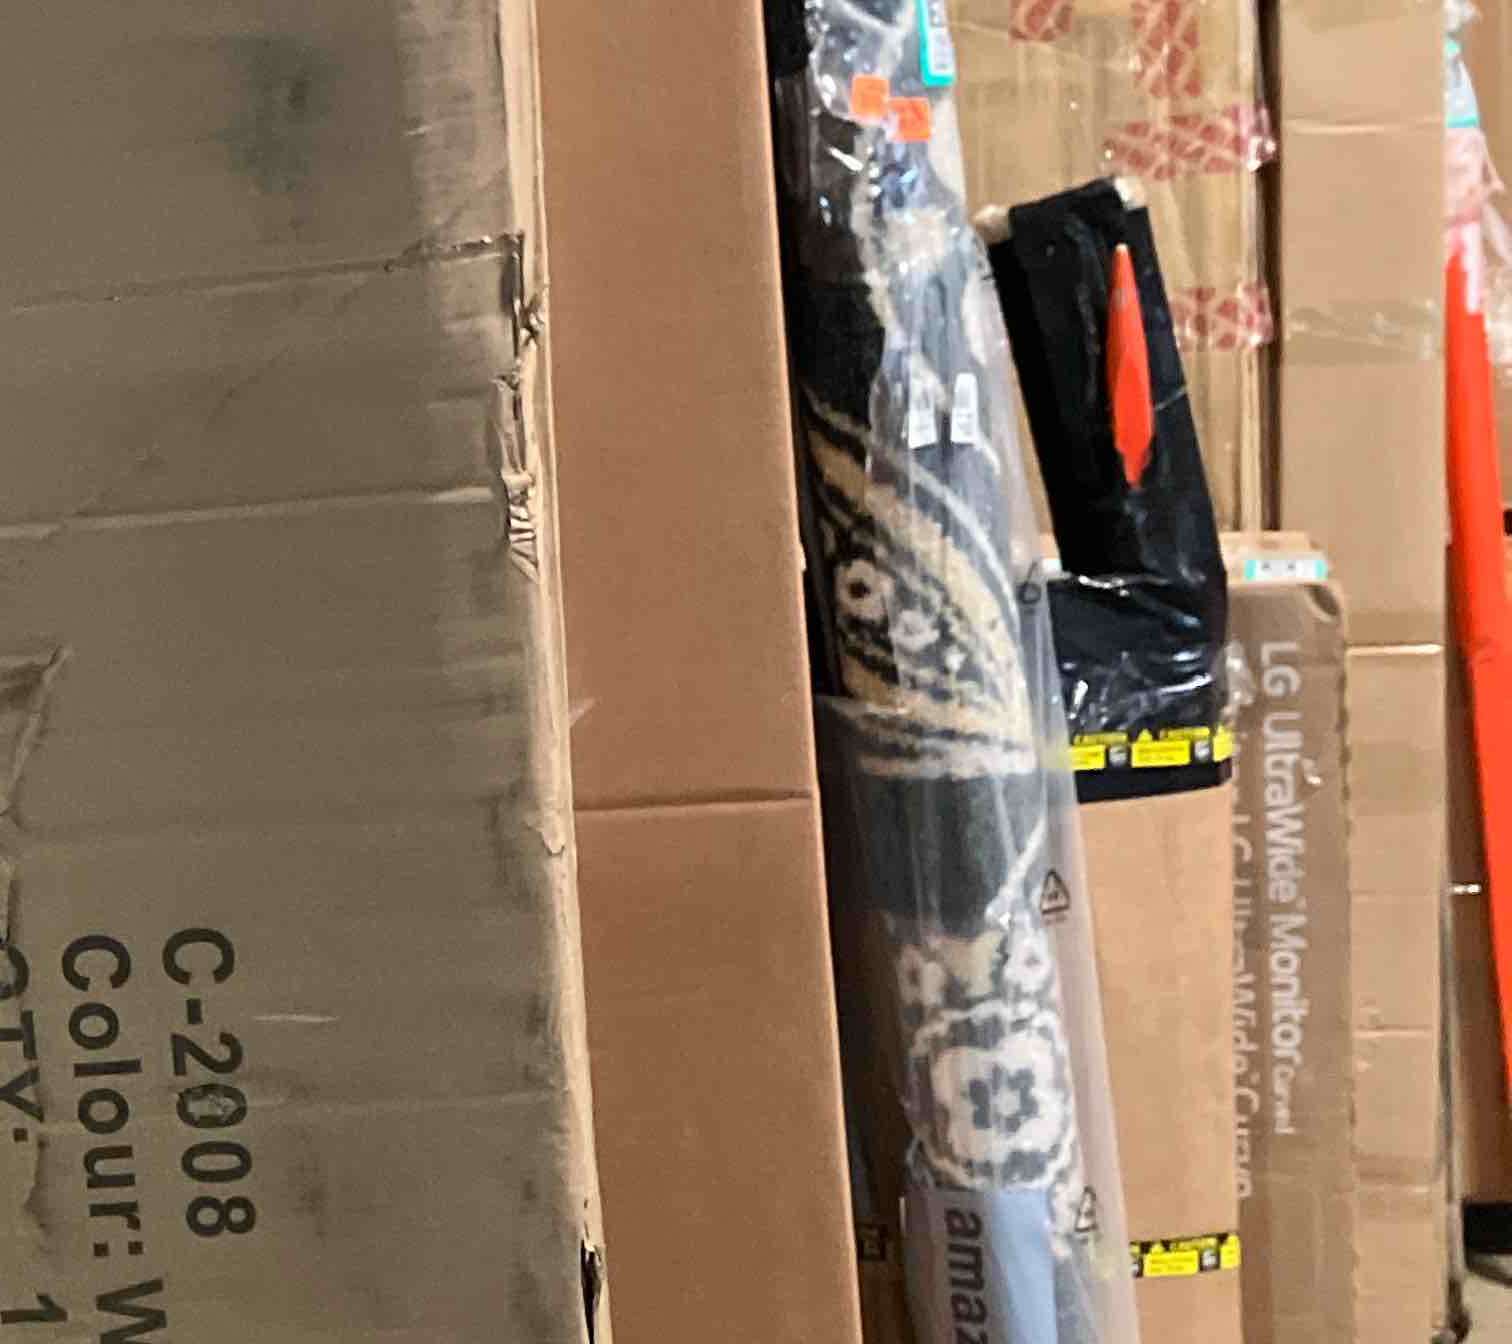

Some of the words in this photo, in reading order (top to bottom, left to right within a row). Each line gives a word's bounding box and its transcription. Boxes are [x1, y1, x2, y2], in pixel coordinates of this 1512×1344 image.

[1261, 640, 1303, 697] LG
[1271, 911, 1308, 1063] Monitor
[61, 934, 144, 1259] Colour:
[162, 927, 256, 1237] C-2008
[0, 1293, 67, 1326] 1
